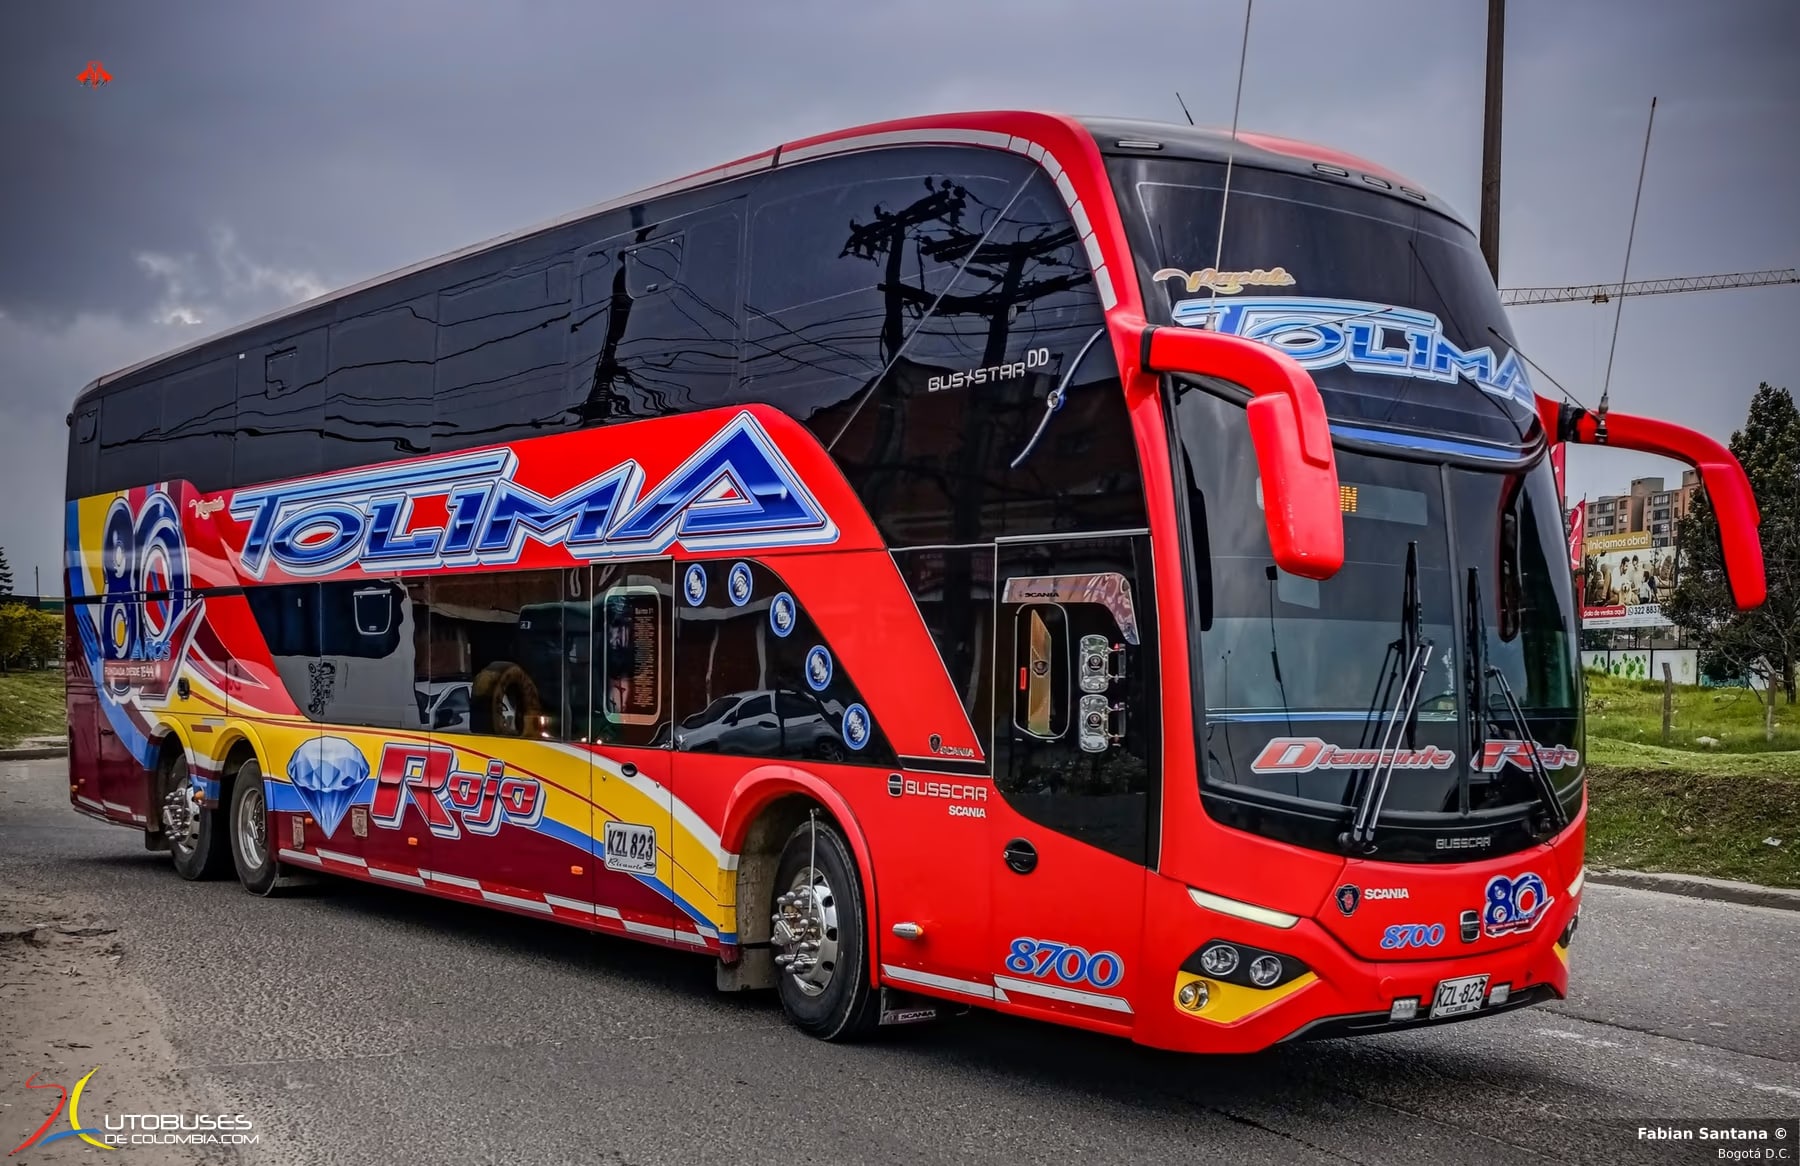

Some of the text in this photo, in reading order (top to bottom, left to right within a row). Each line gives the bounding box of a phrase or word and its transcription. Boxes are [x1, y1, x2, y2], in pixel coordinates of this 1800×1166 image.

[1172, 297, 1536, 409] TOLIMA
[229, 410, 840, 581] TOLIMA
[102, 490, 192, 660] 80
[940, 746, 975, 757] SCANIA
[1250, 737, 1456, 774] Diamante
[369, 742, 547, 839] Rojo
[905, 780, 988, 802] BUSSCAR
[948, 805, 986, 818] SCANIA
[606, 830, 654, 861] KZL 823
[1436, 836, 1491, 850] BUSSCAR
[1364, 888, 1409, 900] SCANIA
[1485, 872, 1547, 926] 80
[1380, 923, 1446, 949] 8700
[1005, 936, 1125, 989] 8700
